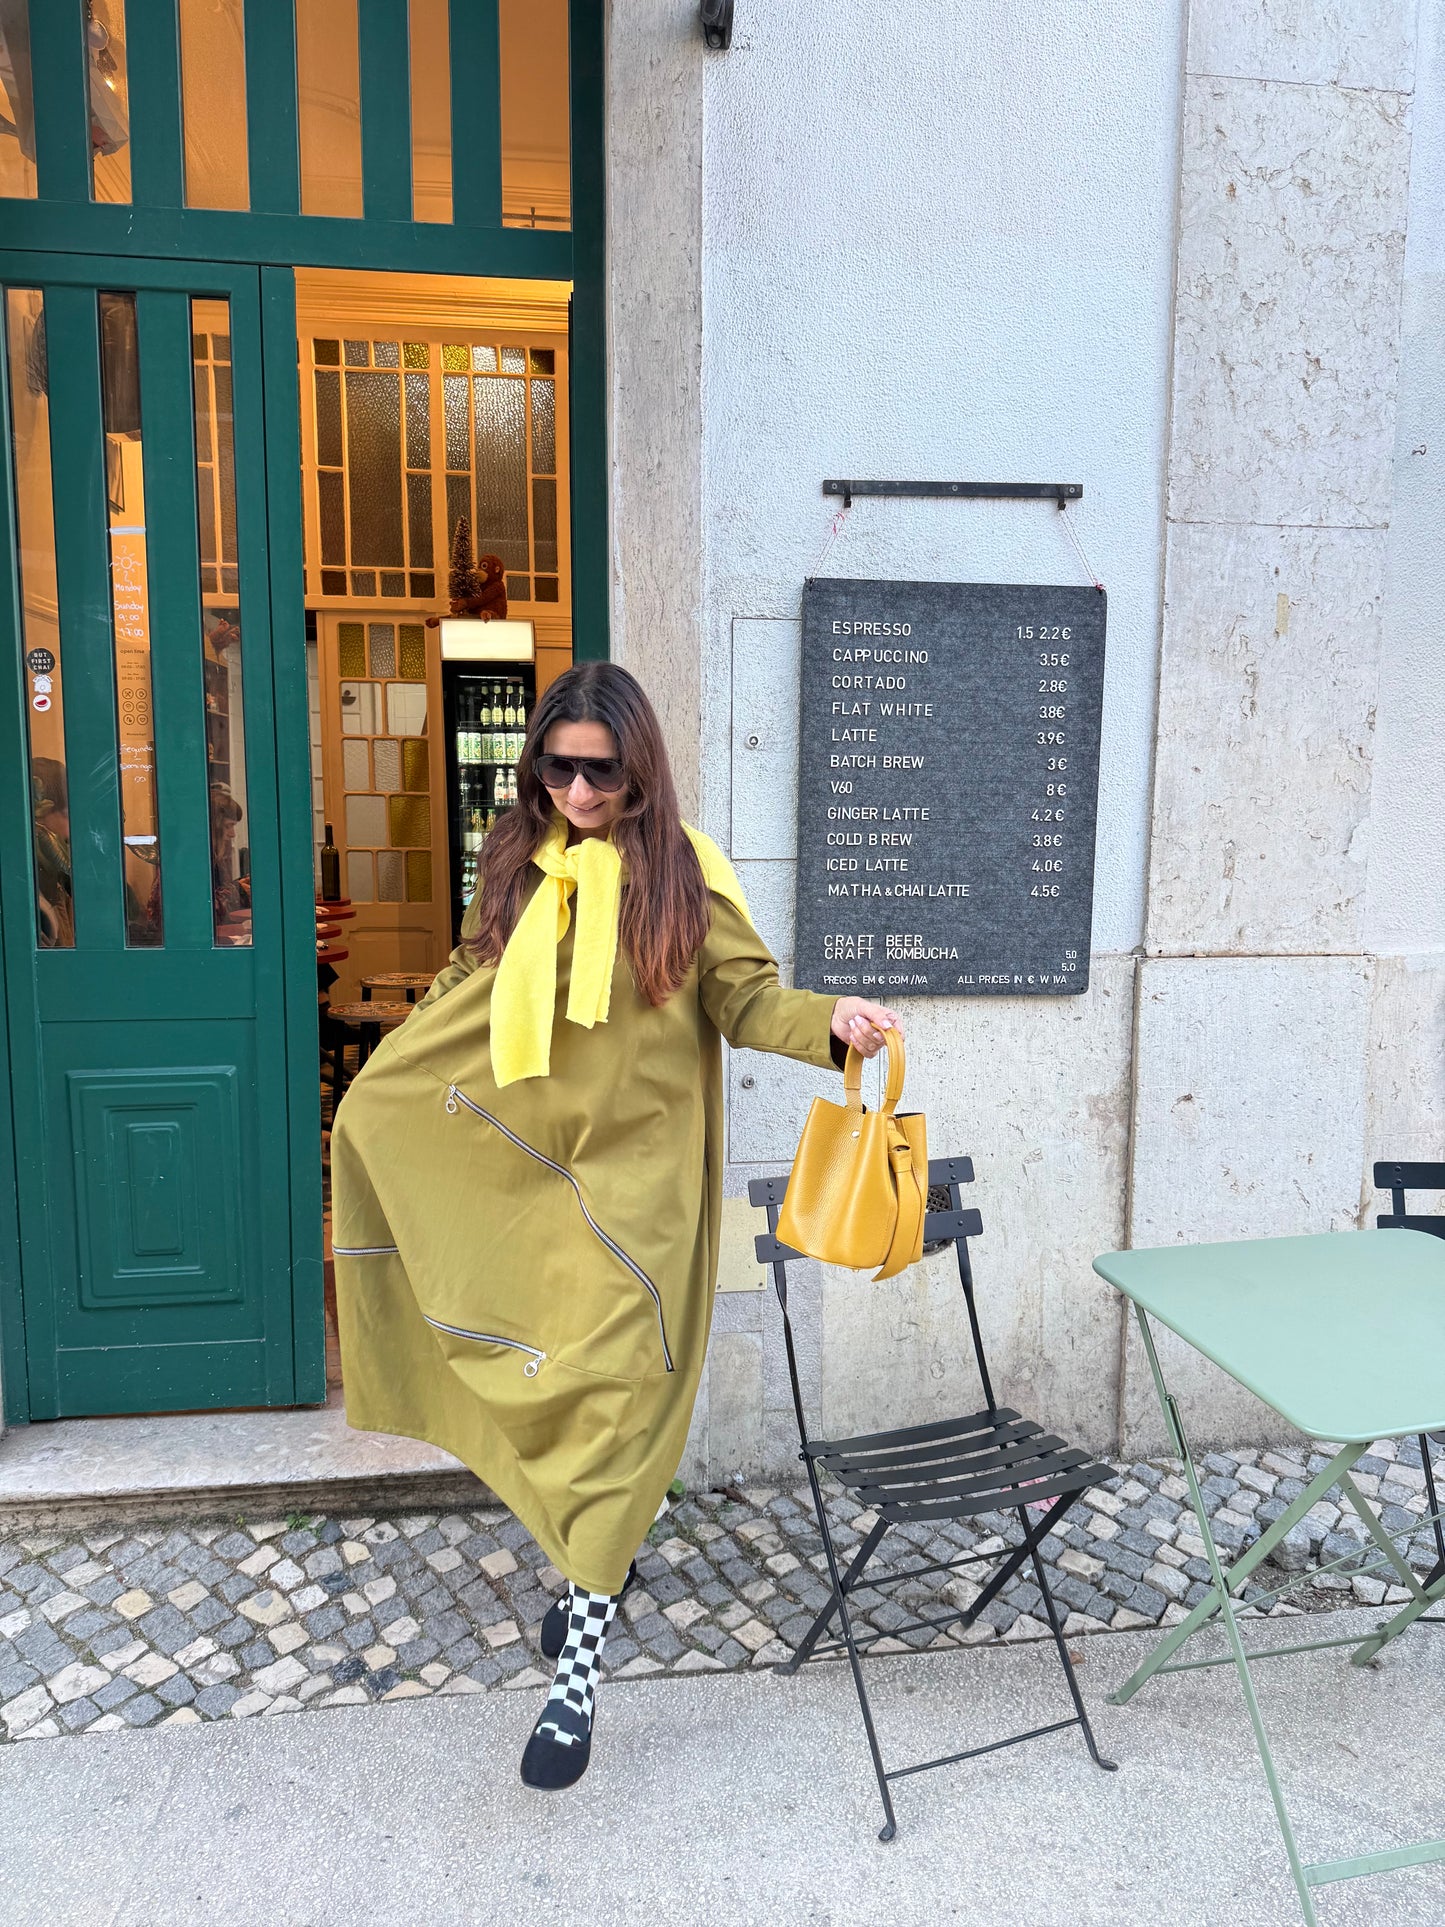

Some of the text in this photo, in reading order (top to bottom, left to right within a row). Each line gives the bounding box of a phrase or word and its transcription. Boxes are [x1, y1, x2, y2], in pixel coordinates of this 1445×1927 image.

[115, 581, 142, 595] Monday
[114, 601, 144, 613] Sunday
[832, 620, 912, 637] ESPRESSO
[1016, 625, 1034, 639] 1.5
[832, 648, 1070, 667] CAPPUCCINO 3.5€
[832, 675, 1068, 693] CORTADO 2.8€
[832, 701, 871, 716] FLAT
[879, 702, 934, 717] WHITE
[831, 728, 1066, 745] LATTE 3.9€
[830, 754, 876, 769] BATCH
[882, 755, 925, 769] BREW
[830, 780, 853, 794] V60
[827, 806, 879, 820] GINGER
[883, 807, 930, 821] LATTE
[826, 832, 1063, 847] COLD BREW 3.8€
[826, 858, 1063, 872] ICED LATTE 4.0€
[928, 884, 970, 897] LATTE
[1030, 884, 1060, 898] 4.5€
[824, 934, 923, 947] CRAFT BEER
[824, 946, 875, 960] CRAFT
[886, 946, 959, 960] KOMBUCHA
[1061, 962, 1076, 972] 5.0
[823, 975, 858, 985] PRECOS
[862, 975, 876, 985] EM
[877, 975, 885, 985] €
[888, 975, 909, 985] COM
[957, 974, 976, 984] ALL
[978, 974, 1011, 984] PRICES
[1013, 975, 1023, 984] IN
[1027, 974, 1035, 984] €
[1039, 974, 1050, 984] W
[1052, 974, 1067, 984] IVA
